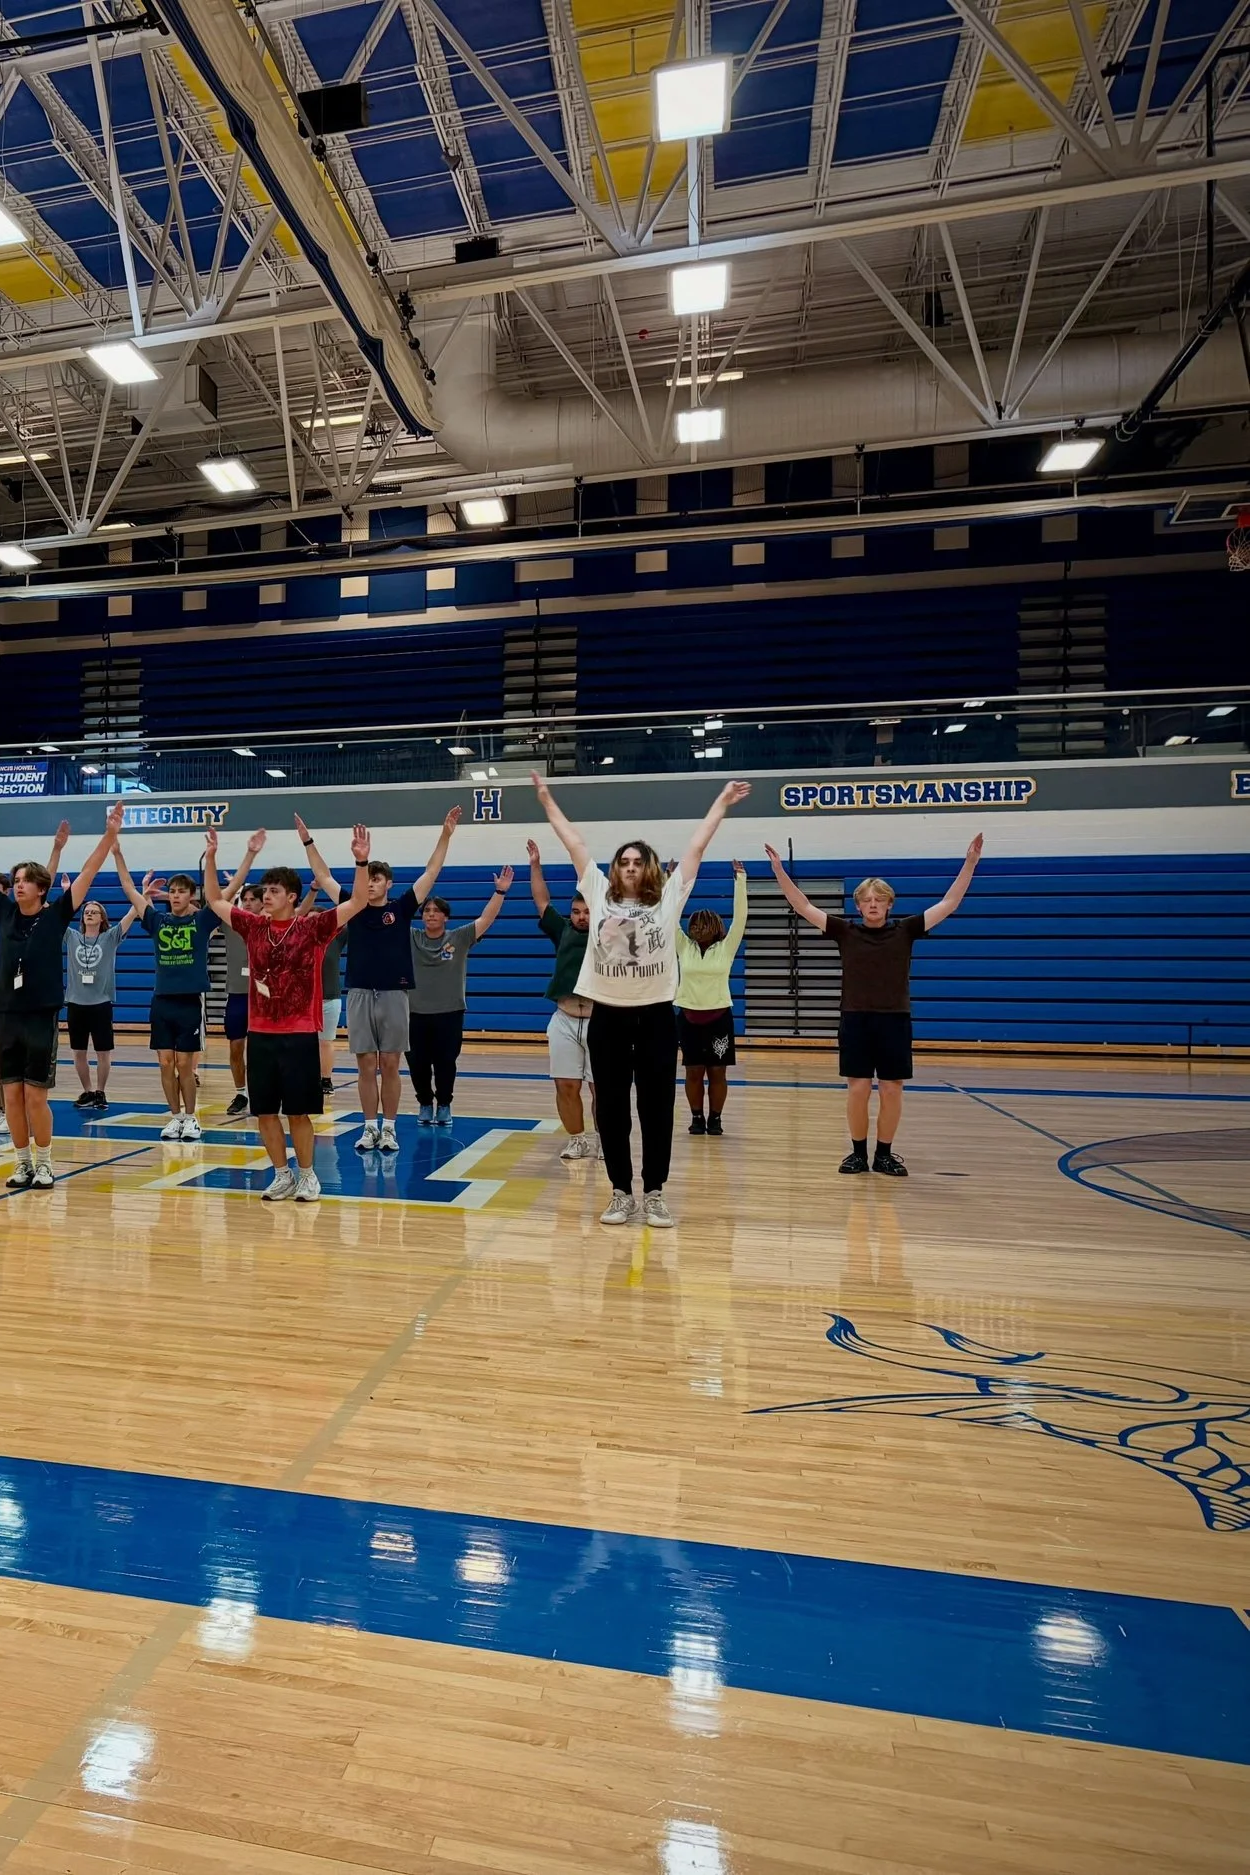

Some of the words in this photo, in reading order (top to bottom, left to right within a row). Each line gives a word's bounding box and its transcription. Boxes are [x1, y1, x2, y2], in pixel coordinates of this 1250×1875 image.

[473, 788, 502, 821] H
[783, 780, 1034, 807] SPORTSMANSHIP
[109, 805, 227, 827] NTEGRITY
